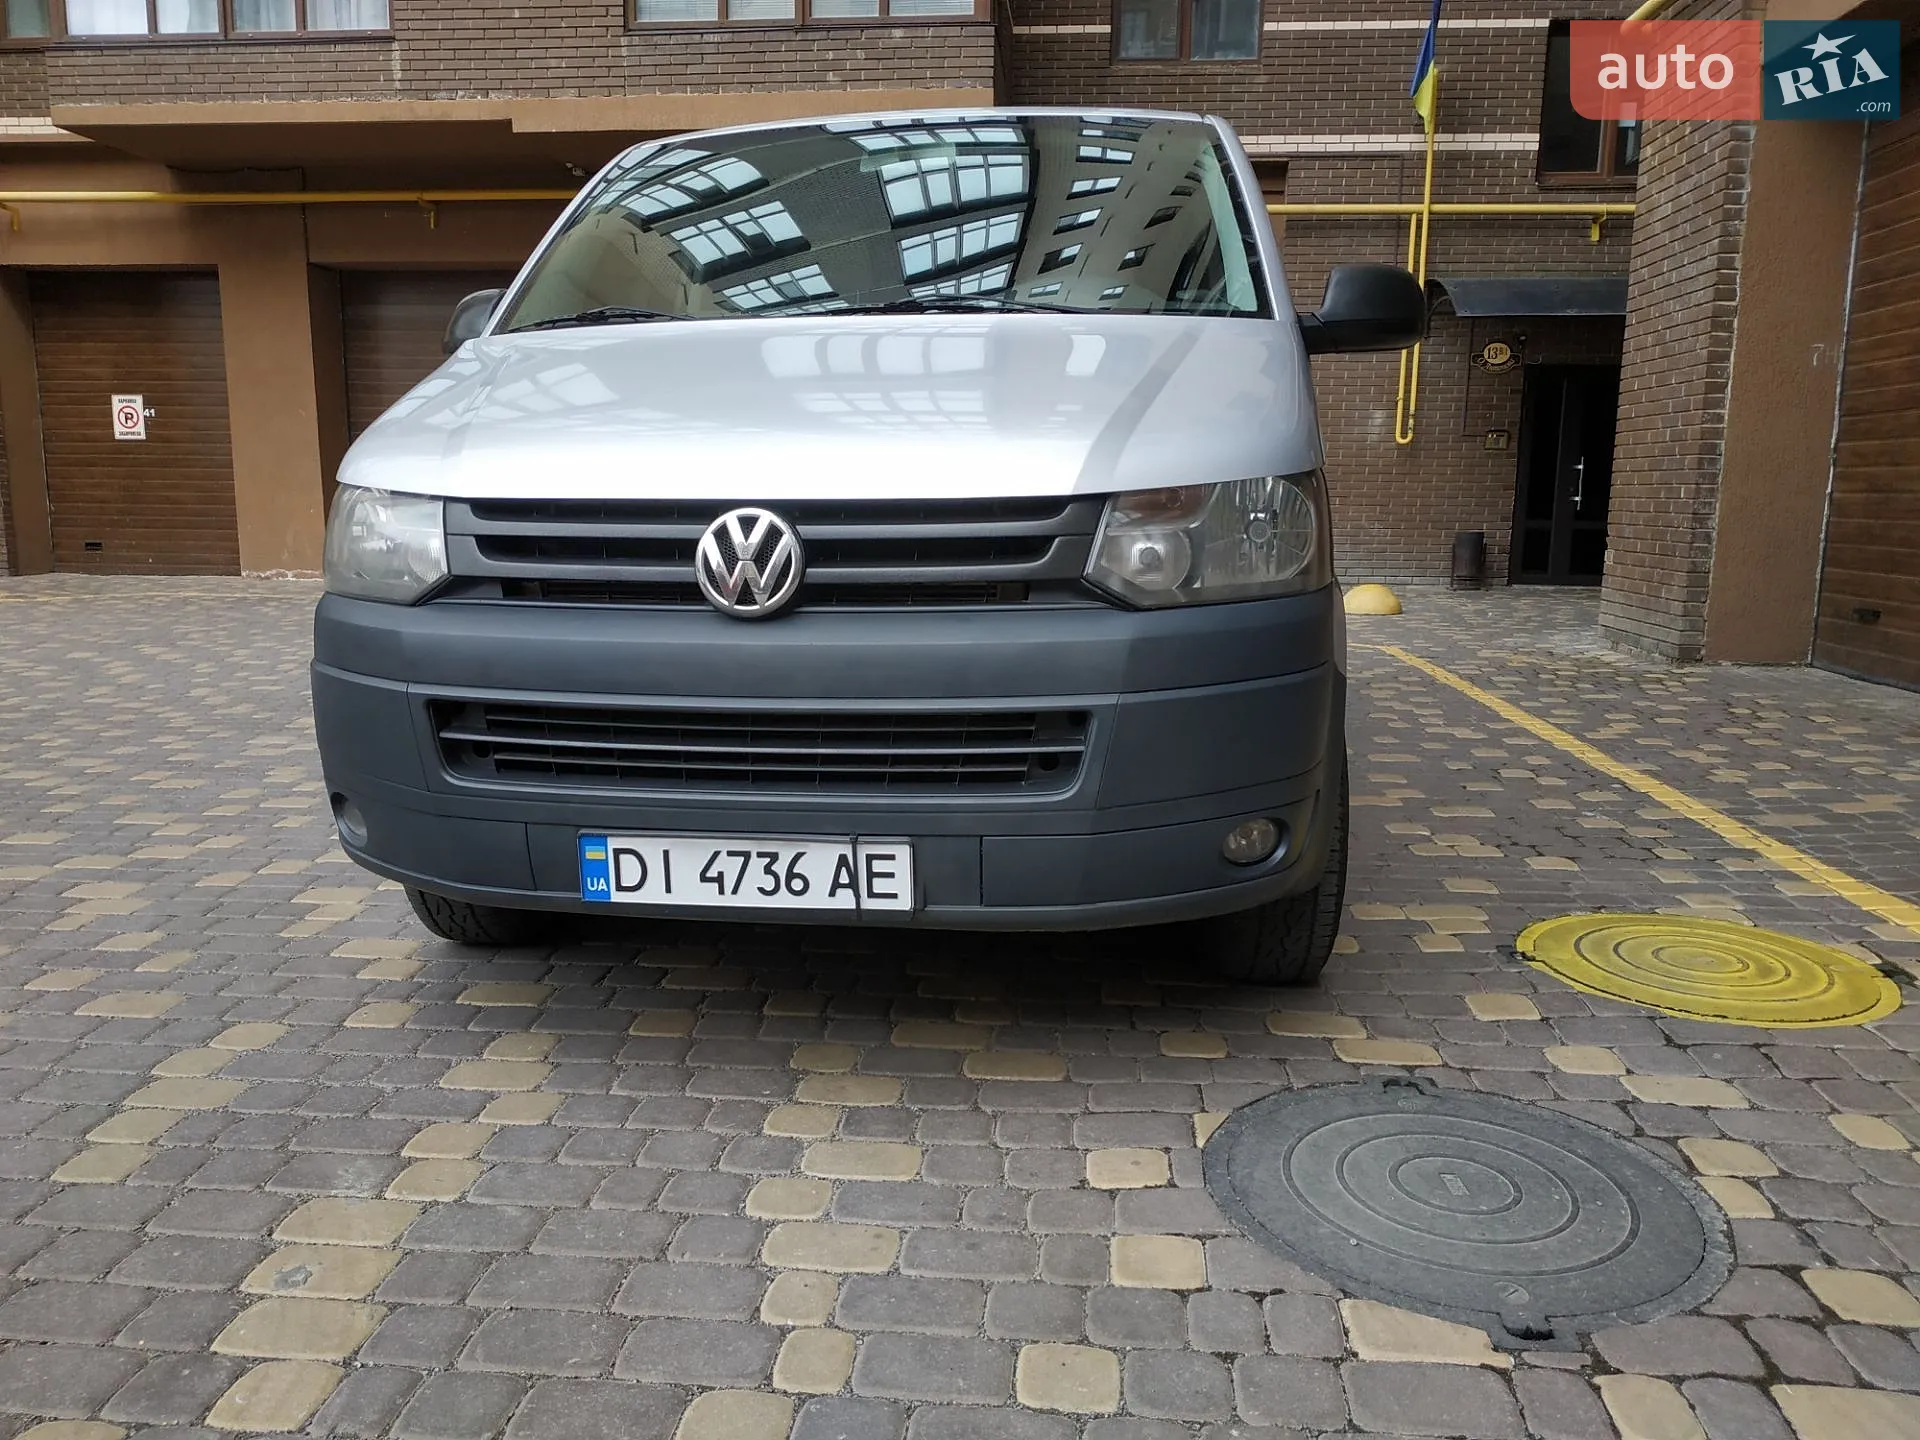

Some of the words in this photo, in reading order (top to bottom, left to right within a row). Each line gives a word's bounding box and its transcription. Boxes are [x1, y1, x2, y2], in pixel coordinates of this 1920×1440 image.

[143, 408, 156, 417] 41
[612, 847, 672, 894] DI
[699, 850, 810, 897] 4736
[828, 853, 899, 899] AE
[586, 876, 609, 892] UA
